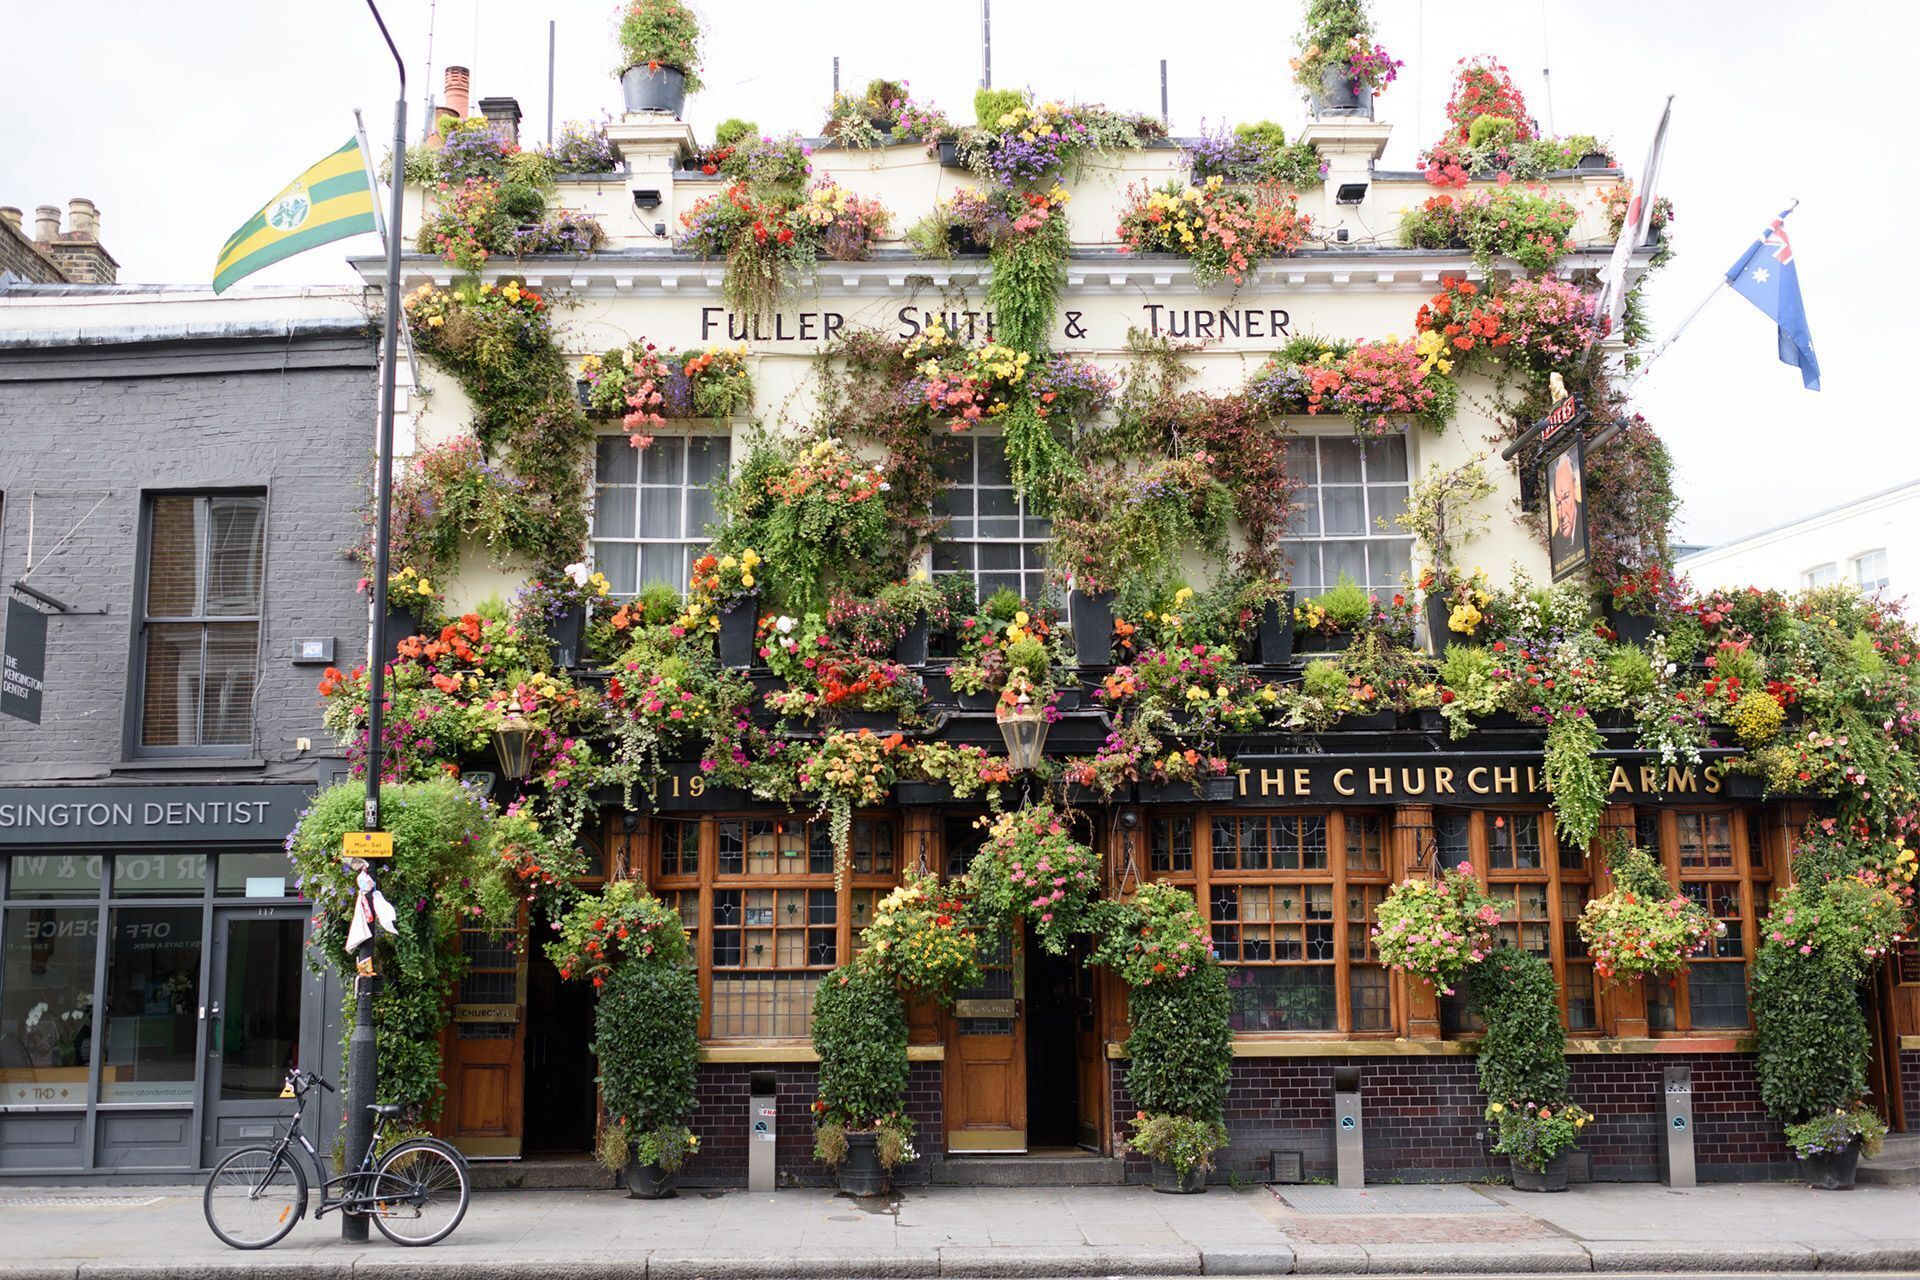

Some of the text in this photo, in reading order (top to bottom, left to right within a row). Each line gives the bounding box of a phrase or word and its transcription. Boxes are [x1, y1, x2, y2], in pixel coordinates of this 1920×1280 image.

[701, 307, 845, 341] FULLER
[1064, 311, 1088, 339] &
[1143, 304, 1290, 338] TURNER
[5, 654, 18, 669] THE
[4, 668, 43, 691] KENSINGTON
[3, 680, 29, 699] DENTIST
[1237, 765, 1722, 796] THE CHURCHI ARMS
[0, 801, 270, 827] SINGTON DENTIST
[258, 907, 275, 916] 117
[961, 1004, 1009, 1013] CHURCHILL
[113, 1088, 192, 1097] kensingtondentist.com
